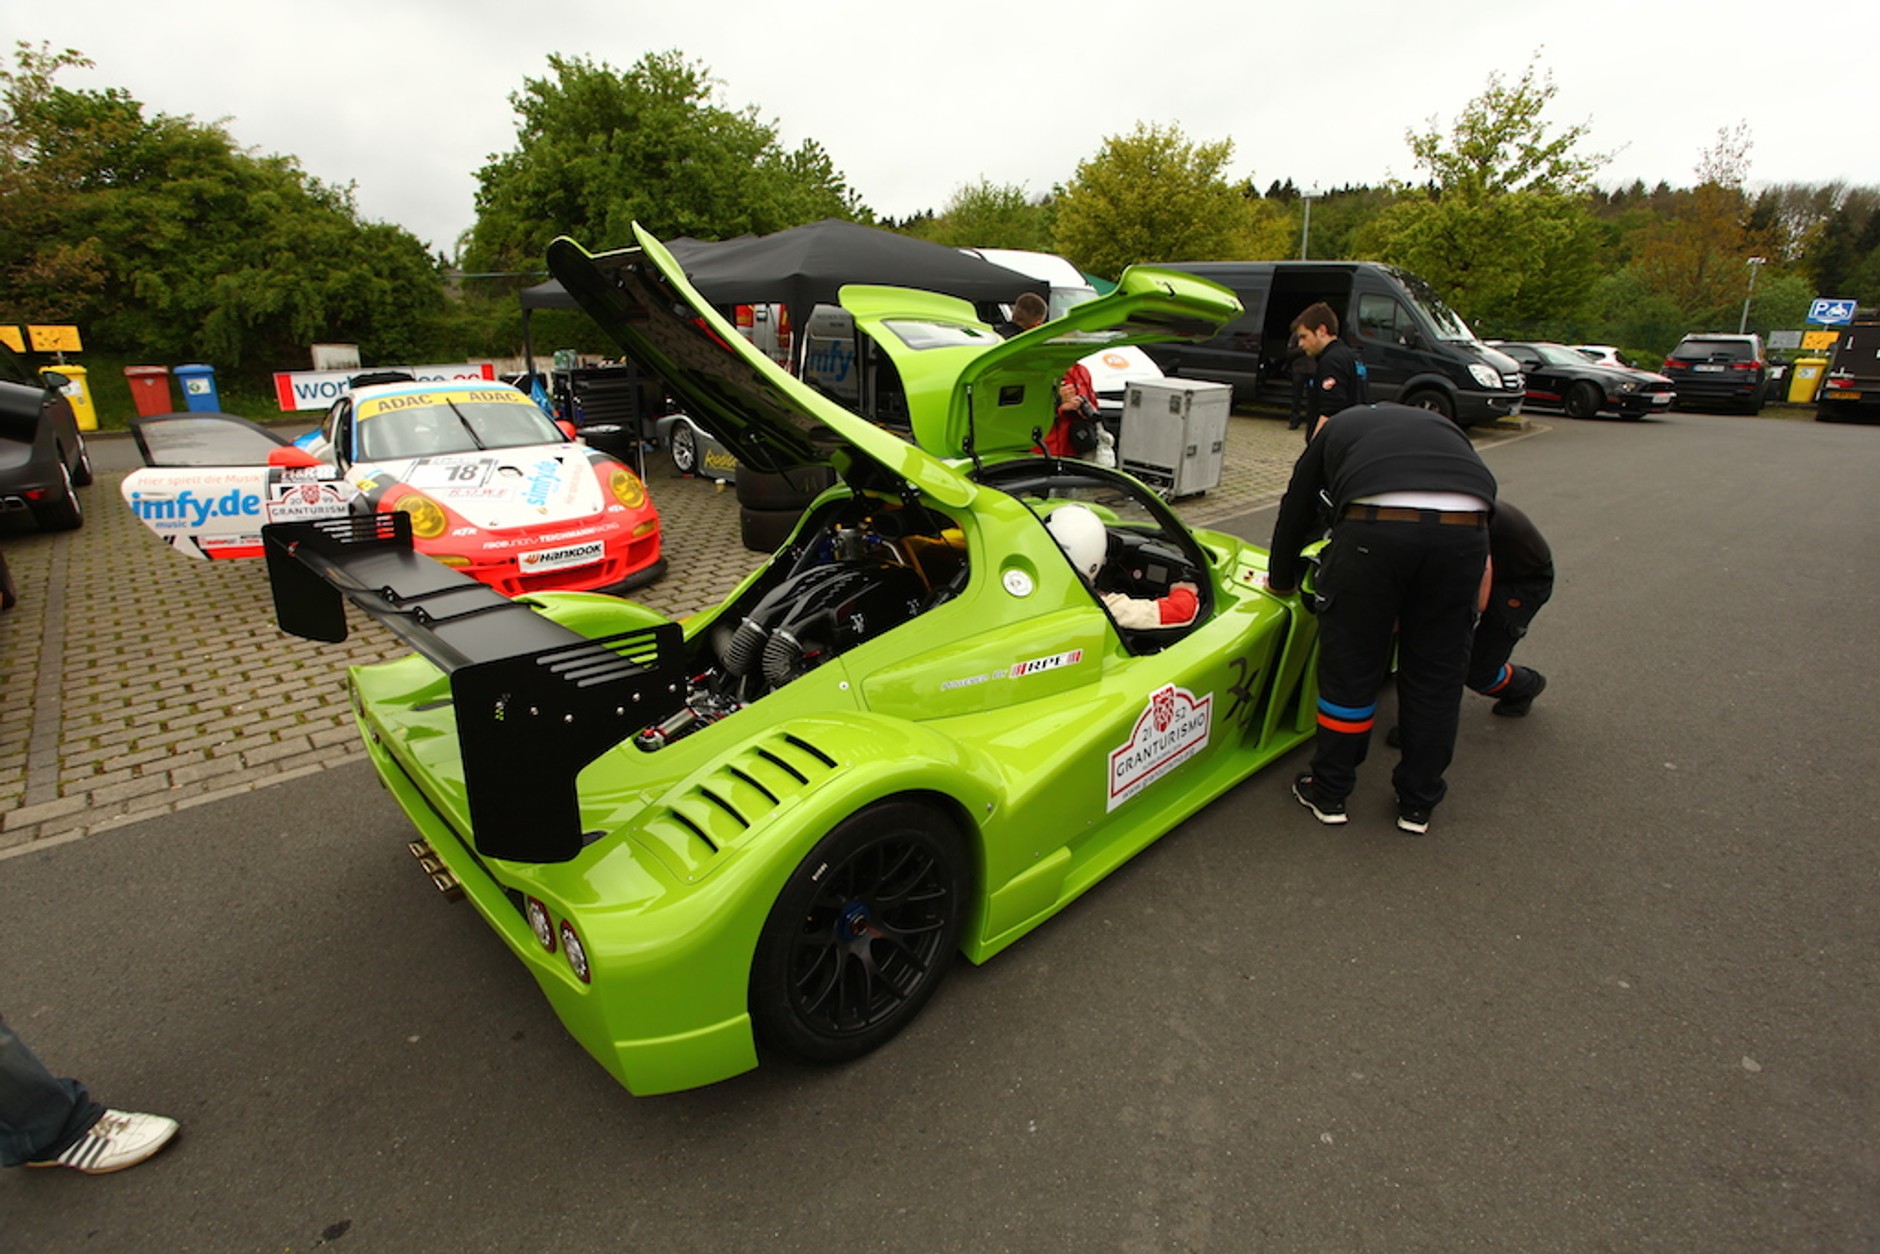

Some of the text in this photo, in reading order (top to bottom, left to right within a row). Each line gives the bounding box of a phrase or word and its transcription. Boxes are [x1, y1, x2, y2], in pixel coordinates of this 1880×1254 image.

[1814, 302, 1828, 316] P
[810, 340, 853, 382] mfy
[378, 391, 519, 411] ADAC ADAC
[445, 465, 479, 481] 18
[132, 489, 260, 527] imfy.de
[271, 506, 346, 516] GRANTURISM
[1116, 712, 1206, 777] GRANTURISMO
